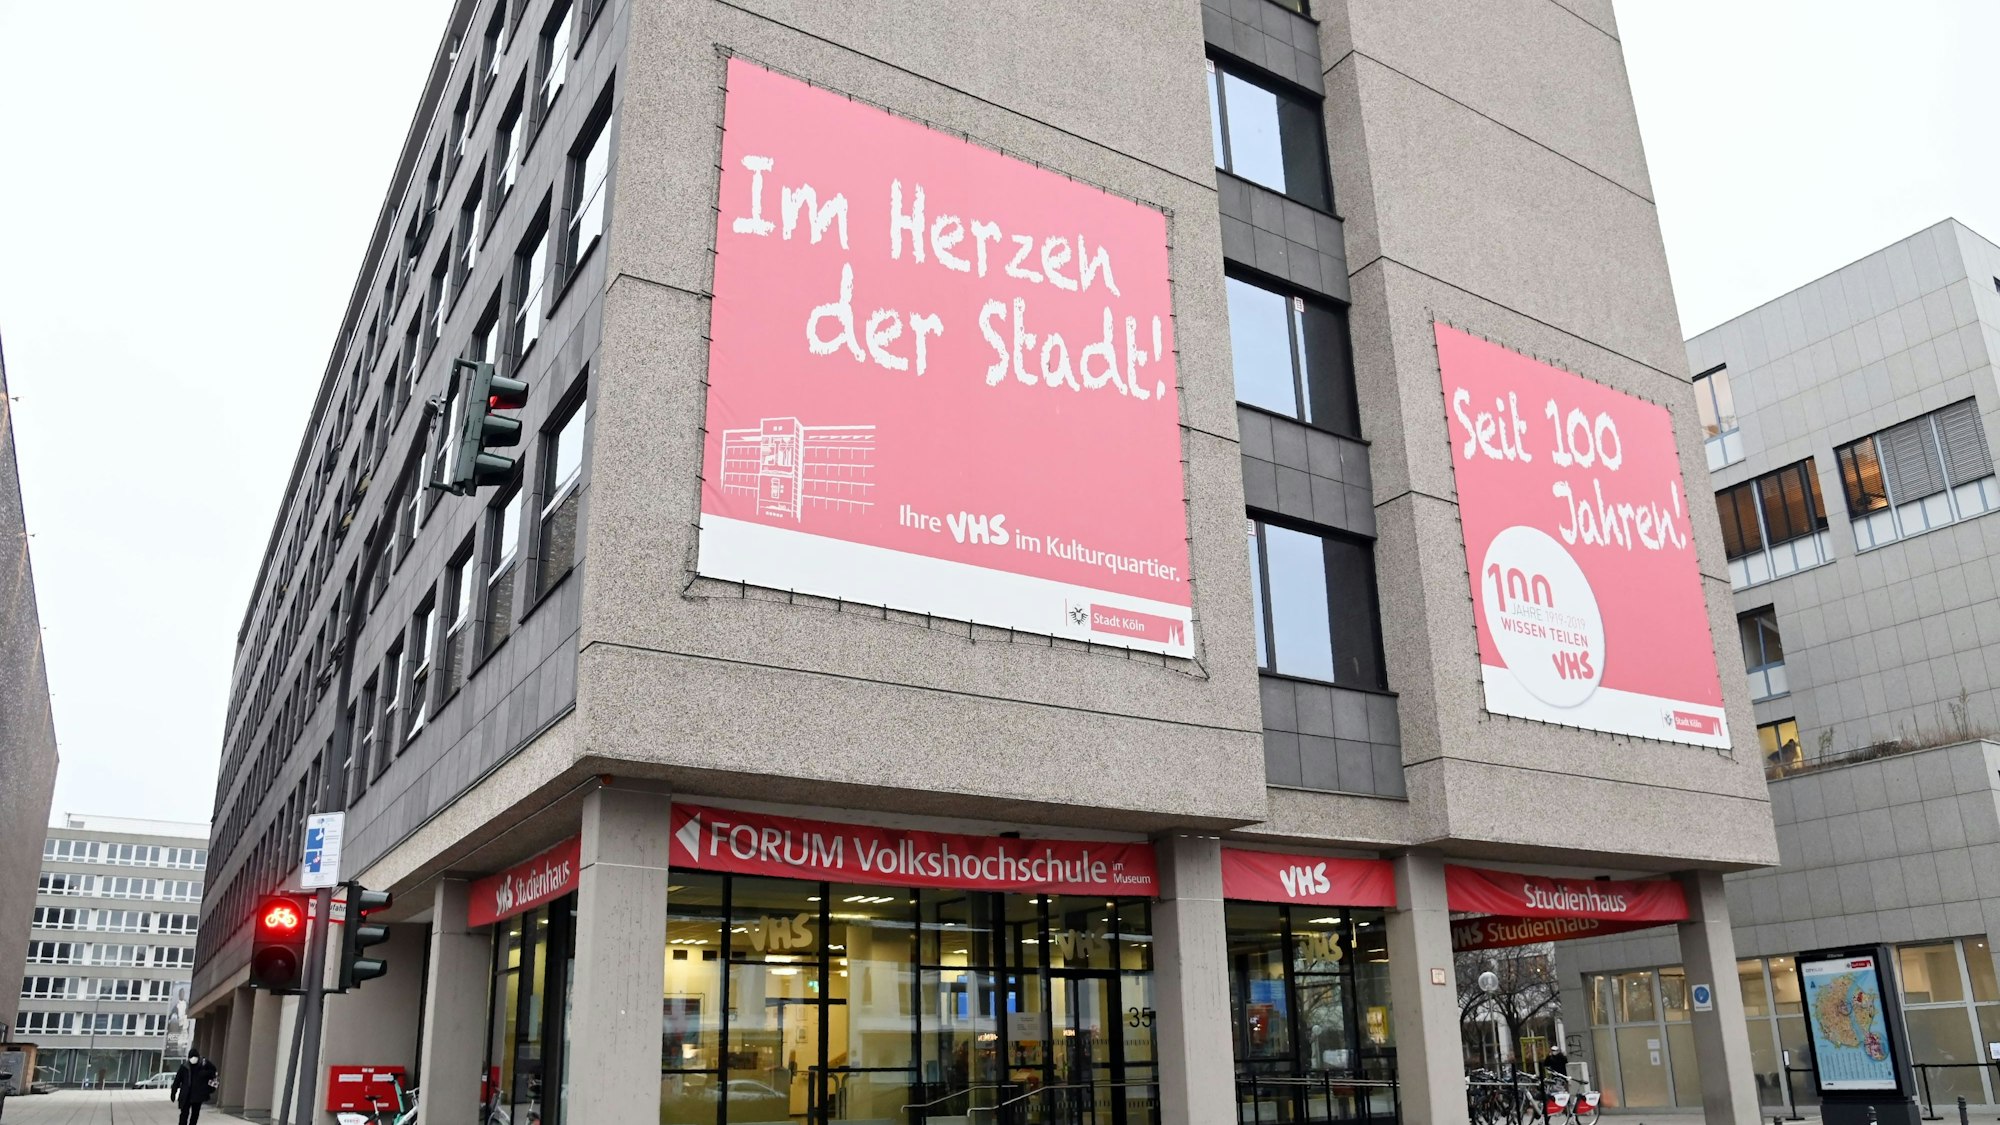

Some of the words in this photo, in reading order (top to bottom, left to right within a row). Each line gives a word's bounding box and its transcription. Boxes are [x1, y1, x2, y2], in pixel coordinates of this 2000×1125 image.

[733, 154, 850, 250] Im
[890, 178, 1120, 298] Herzen
[806, 262, 945, 376] der
[978, 297, 1166, 400] Stadt!
[1453, 387, 1532, 463] Seit
[1545, 399, 1622, 471] 100
[1552, 478, 1686, 551] Jahren!
[899, 504, 941, 533] Ihre
[946, 511, 1010, 546] VHS
[1015, 529, 1041, 554] im
[1046, 535, 1180, 582] Kulturquartier.
[1093, 612, 1121, 628] Stadt
[1122, 617, 1145, 632] Köln
[1511, 603, 1541, 622] JAHRE
[1501, 616, 1546, 639] WISSEN
[1549, 627, 1588, 648] TEILEN
[1552, 650, 1594, 680] VHS
[710, 821, 843, 869] FORUM
[853, 837, 1107, 884] Volkshochschule
[1112, 860, 1124, 871] im
[496, 874, 514, 917] VHS
[515, 860, 571, 907] Studienhaus
[1113, 873, 1152, 884] Museum
[1279, 862, 1331, 898] VHS
[1524, 883, 1627, 912] Studienhaus
[745, 913, 813, 952] VHS
[1058, 926, 1110, 960] VHS
[1487, 917, 1599, 943] Studienhaus
[1299, 932, 1344, 963] VHS
[1129, 1006, 1152, 1028] 35
